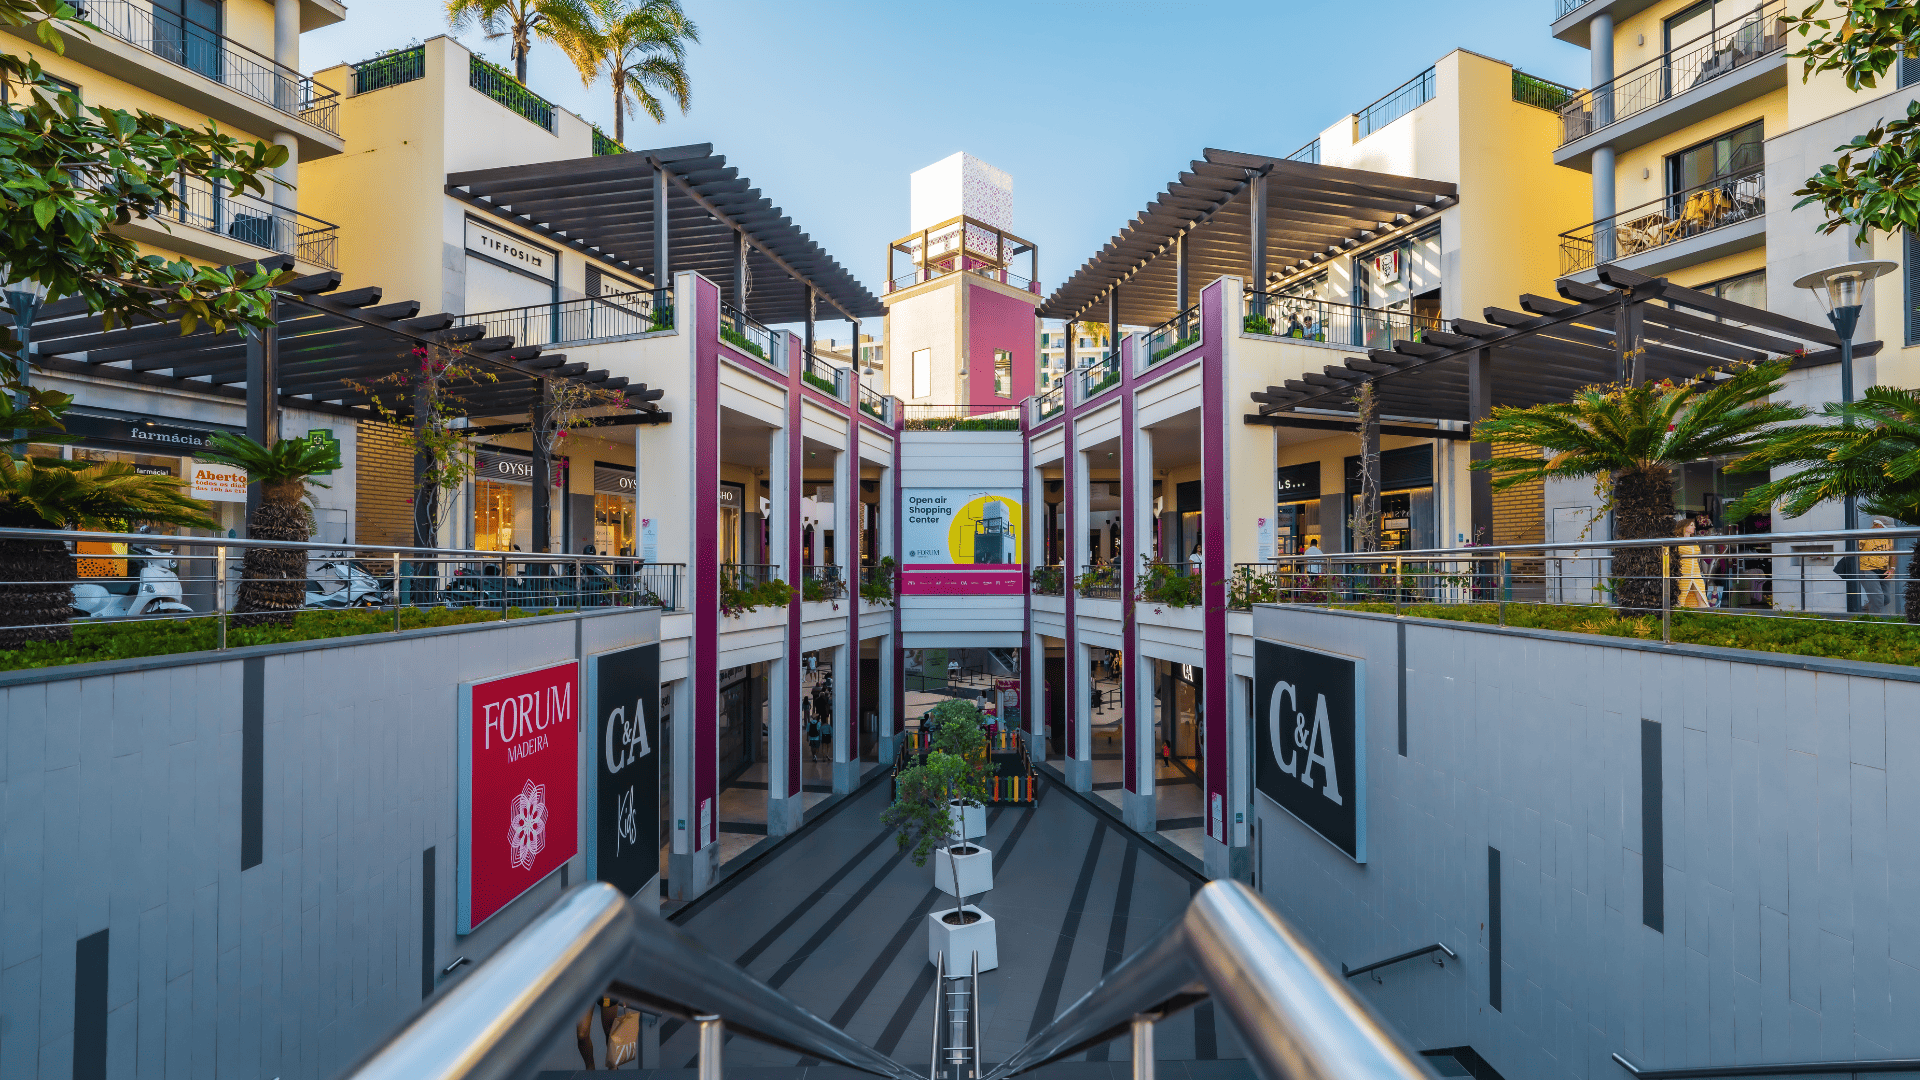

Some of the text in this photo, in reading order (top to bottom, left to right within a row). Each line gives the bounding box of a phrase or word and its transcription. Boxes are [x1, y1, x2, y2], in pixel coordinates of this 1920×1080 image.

[481, 235, 529, 262] TIFFOSI
[131, 428, 202, 446] farmácia
[195, 469, 247, 483] Aberto
[909, 495, 947, 505] Open air
[909, 506, 952, 516] Shopping
[482, 681, 571, 749] FORUM
[507, 733, 549, 764] MADEIRA
[605, 698, 651, 774] C&A
[1269, 680, 1343, 806] C&A
[616, 785, 637, 858] Kids
